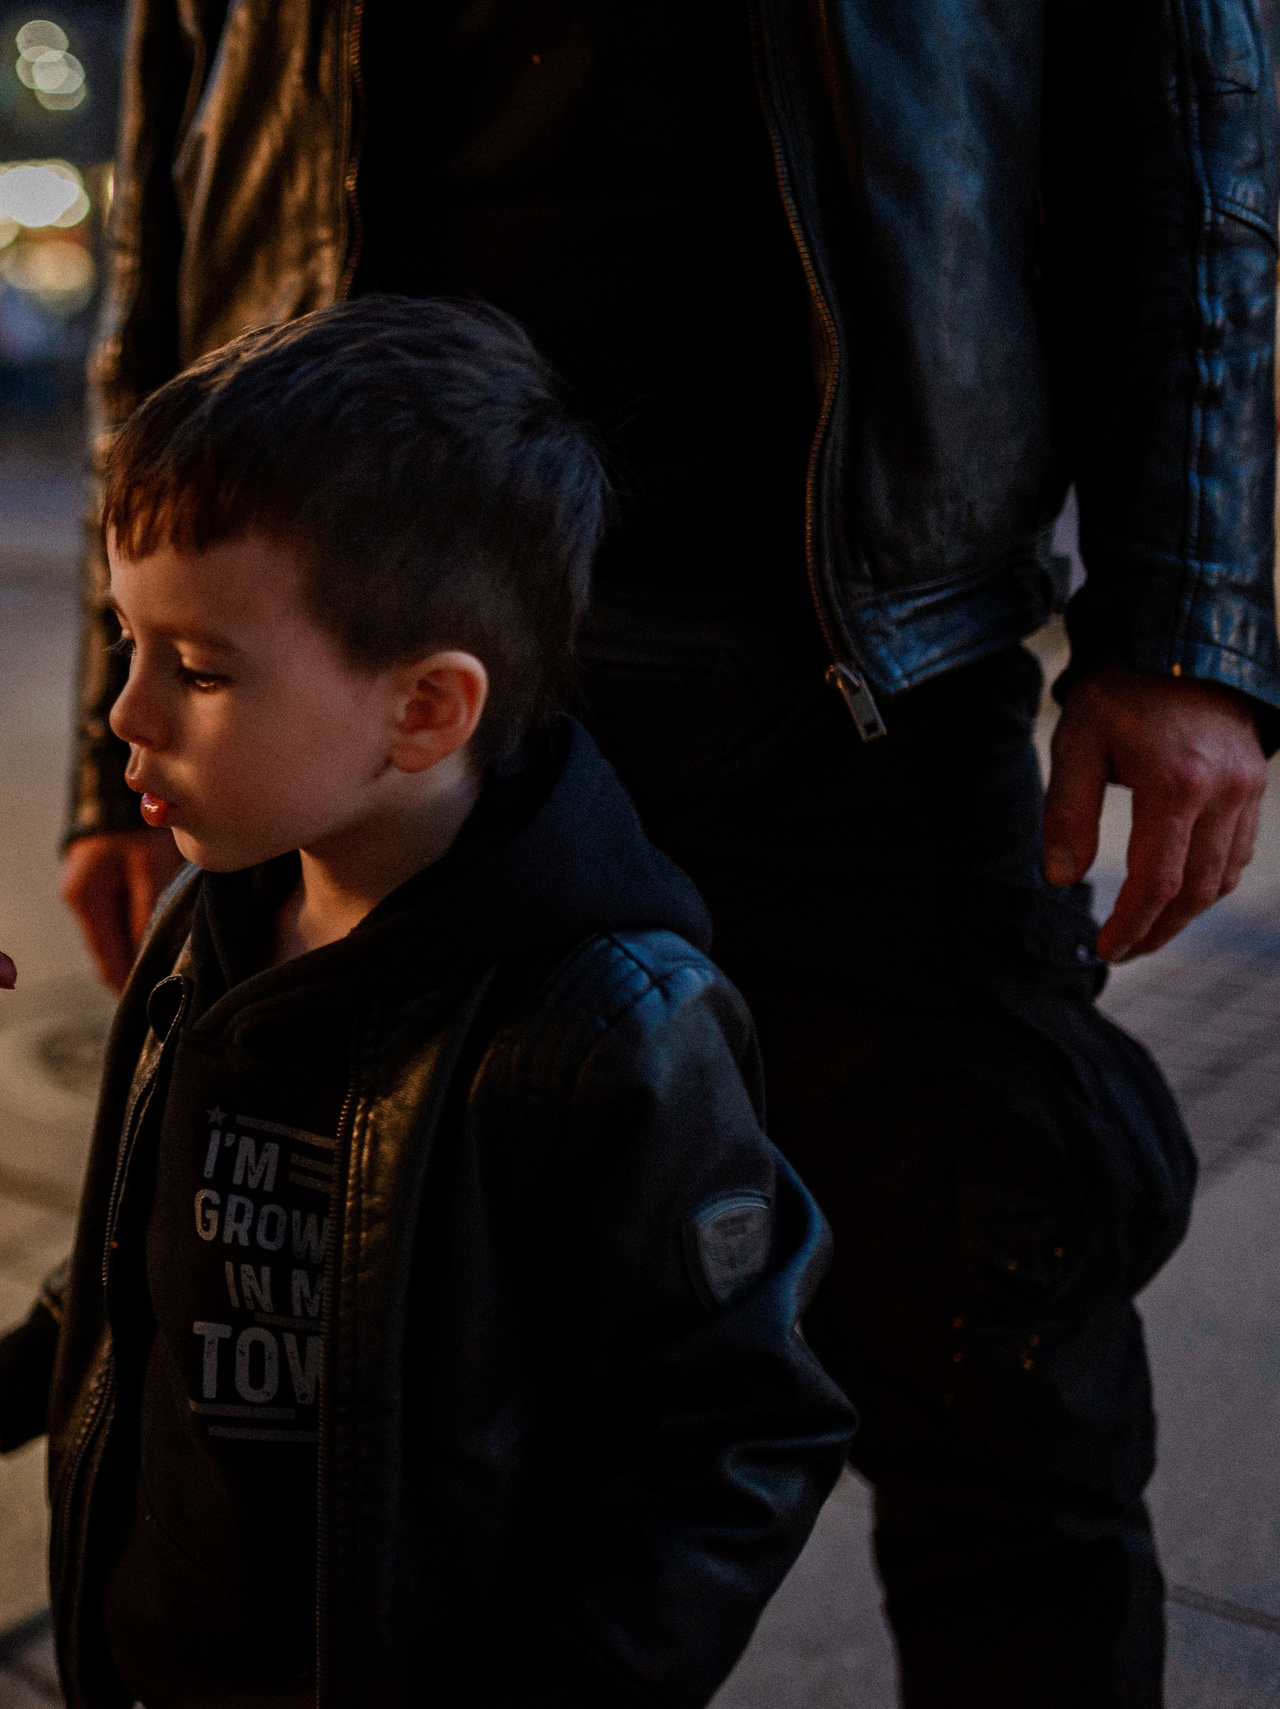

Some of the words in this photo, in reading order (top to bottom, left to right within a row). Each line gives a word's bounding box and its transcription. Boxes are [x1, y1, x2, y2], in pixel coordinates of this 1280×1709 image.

[203, 1130, 279, 1192] I'M
[194, 1189, 329, 1265] GROW
[224, 1261, 274, 1313] IN
